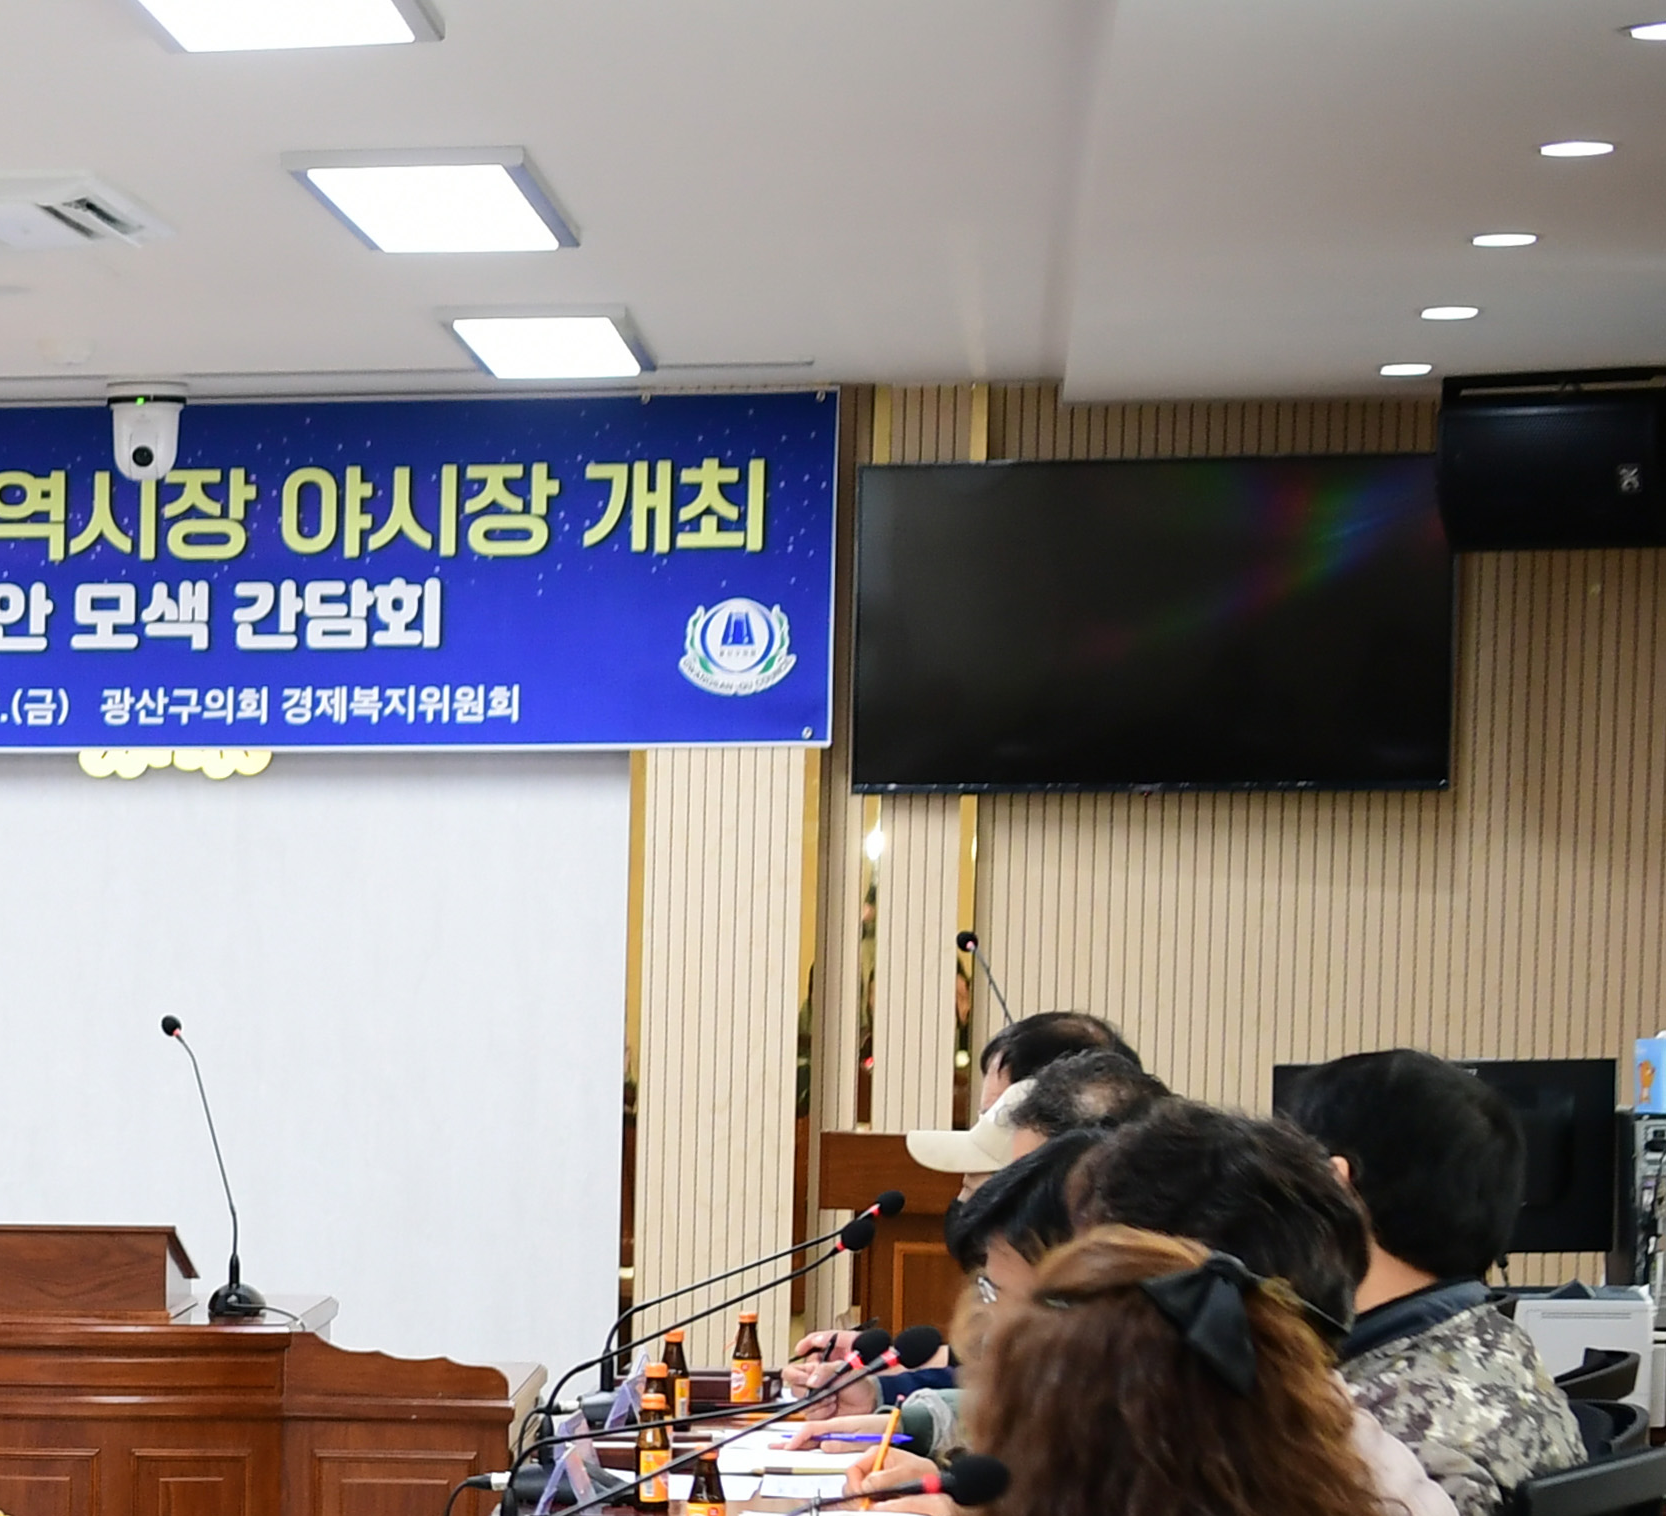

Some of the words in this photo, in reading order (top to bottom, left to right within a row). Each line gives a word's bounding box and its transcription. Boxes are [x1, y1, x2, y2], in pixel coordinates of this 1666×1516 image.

[280, 464, 560, 559] 야시장
[582, 458, 766, 554] 개최
[70, 580, 209, 651] 모색
[232, 577, 441, 650] 간담회
[100, 686, 269, 726] 광산구의회
[281, 683, 520, 725] 경제복지위원회
